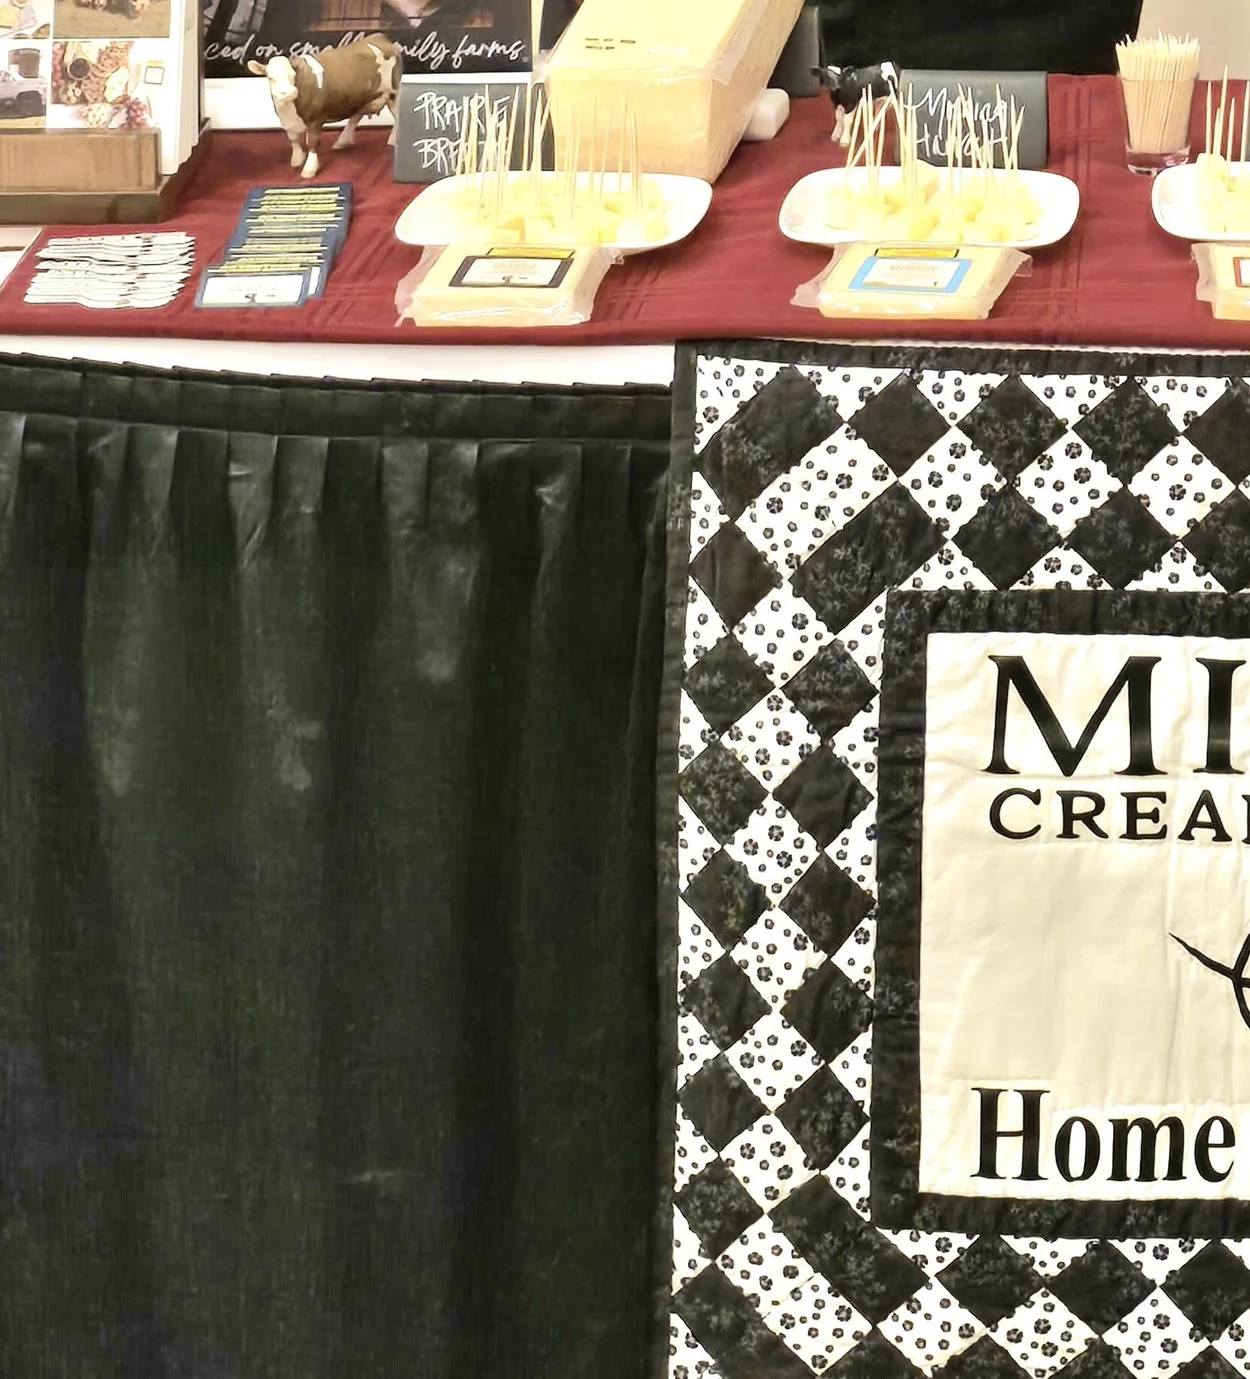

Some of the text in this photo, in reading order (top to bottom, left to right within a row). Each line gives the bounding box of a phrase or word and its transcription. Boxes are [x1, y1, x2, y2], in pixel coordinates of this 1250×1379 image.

[255, 43, 283, 58] on
[452, 34, 526, 69] farms
[414, 92, 511, 134] PRARE
[971, 1087, 1236, 1183] Home
